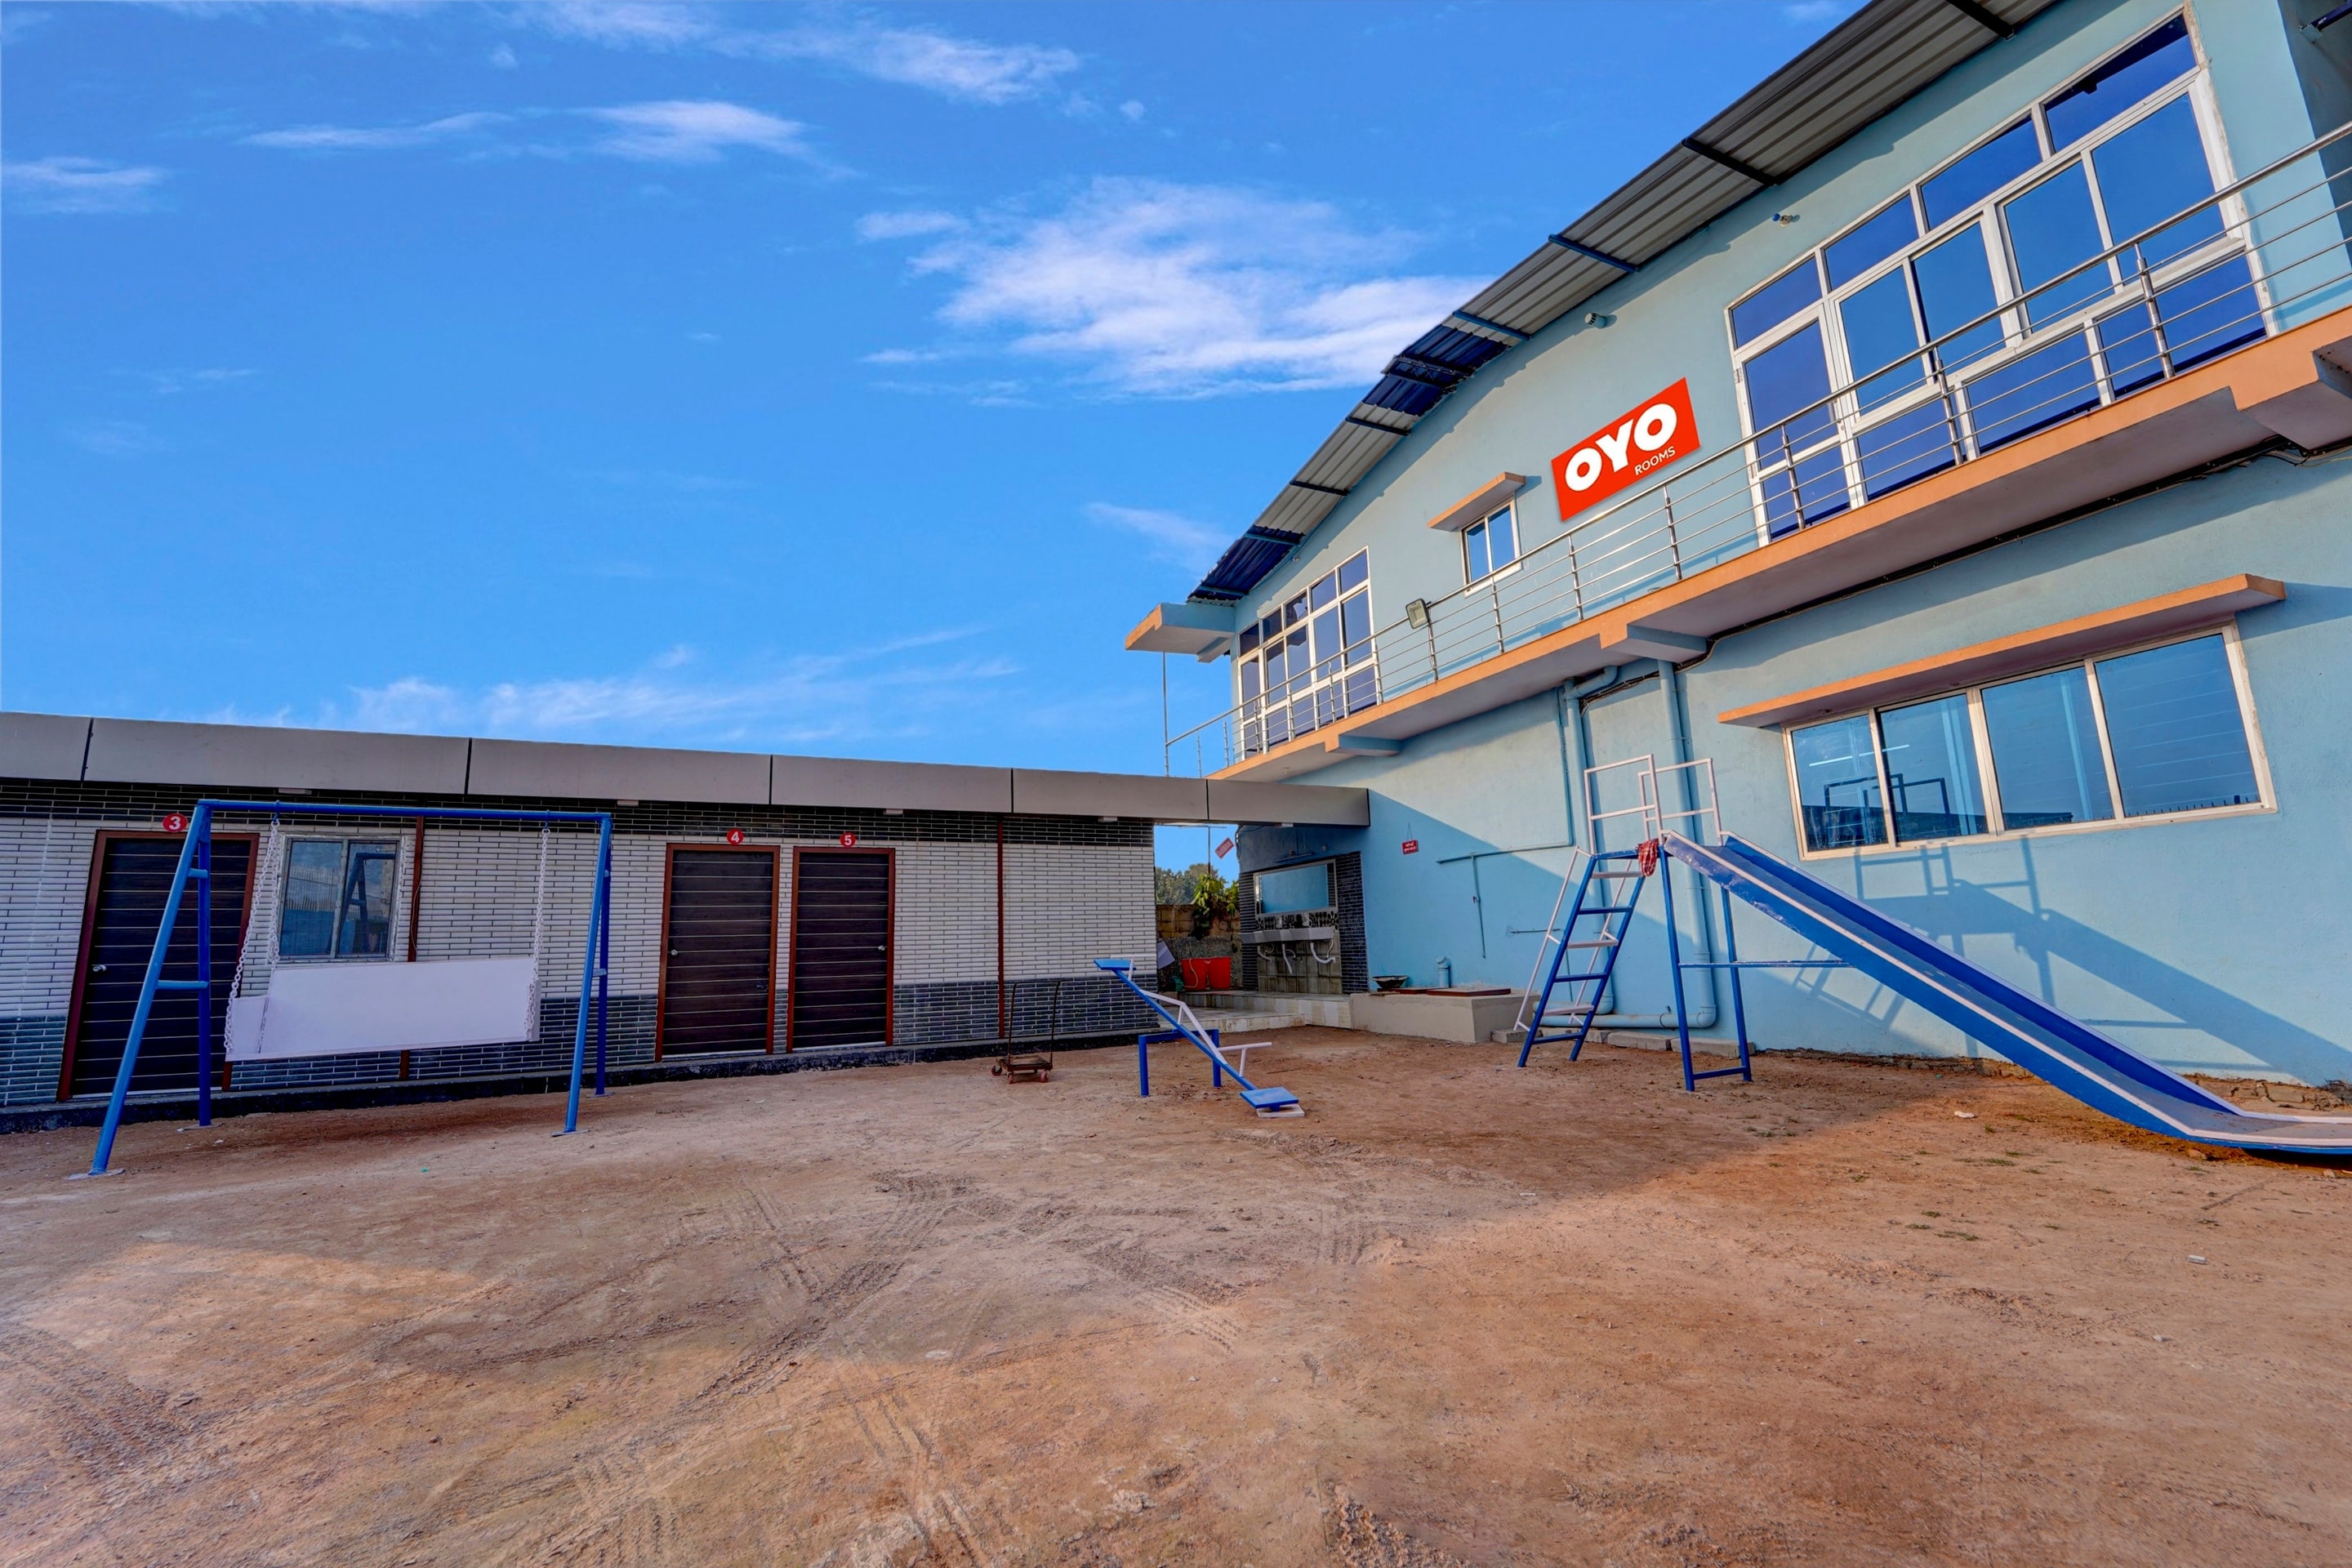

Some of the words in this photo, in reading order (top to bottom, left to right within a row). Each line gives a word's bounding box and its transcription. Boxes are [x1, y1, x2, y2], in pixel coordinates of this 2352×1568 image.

[1565, 403, 1677, 492] OYO
[1634, 446, 1676, 475] ROOMS
[168, 816, 181, 831] 3
[731, 831, 740, 843] 4
[844, 835, 853, 846] 5
